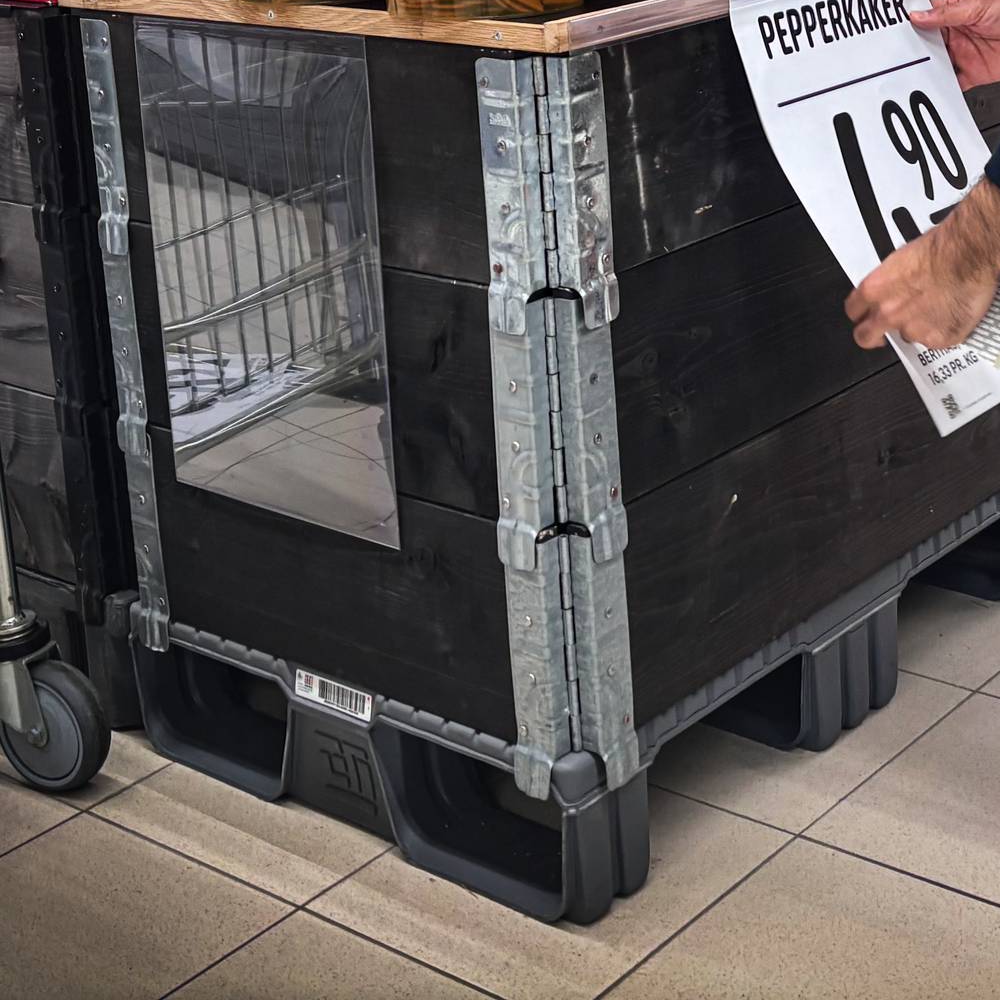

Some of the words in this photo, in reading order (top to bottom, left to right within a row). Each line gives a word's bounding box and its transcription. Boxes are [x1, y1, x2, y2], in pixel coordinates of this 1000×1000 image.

[881, 89, 969, 201] 90
[928, 364, 952, 386] 16,33
[949, 358, 967, 374] PR.
[962, 350, 979, 367] KG
